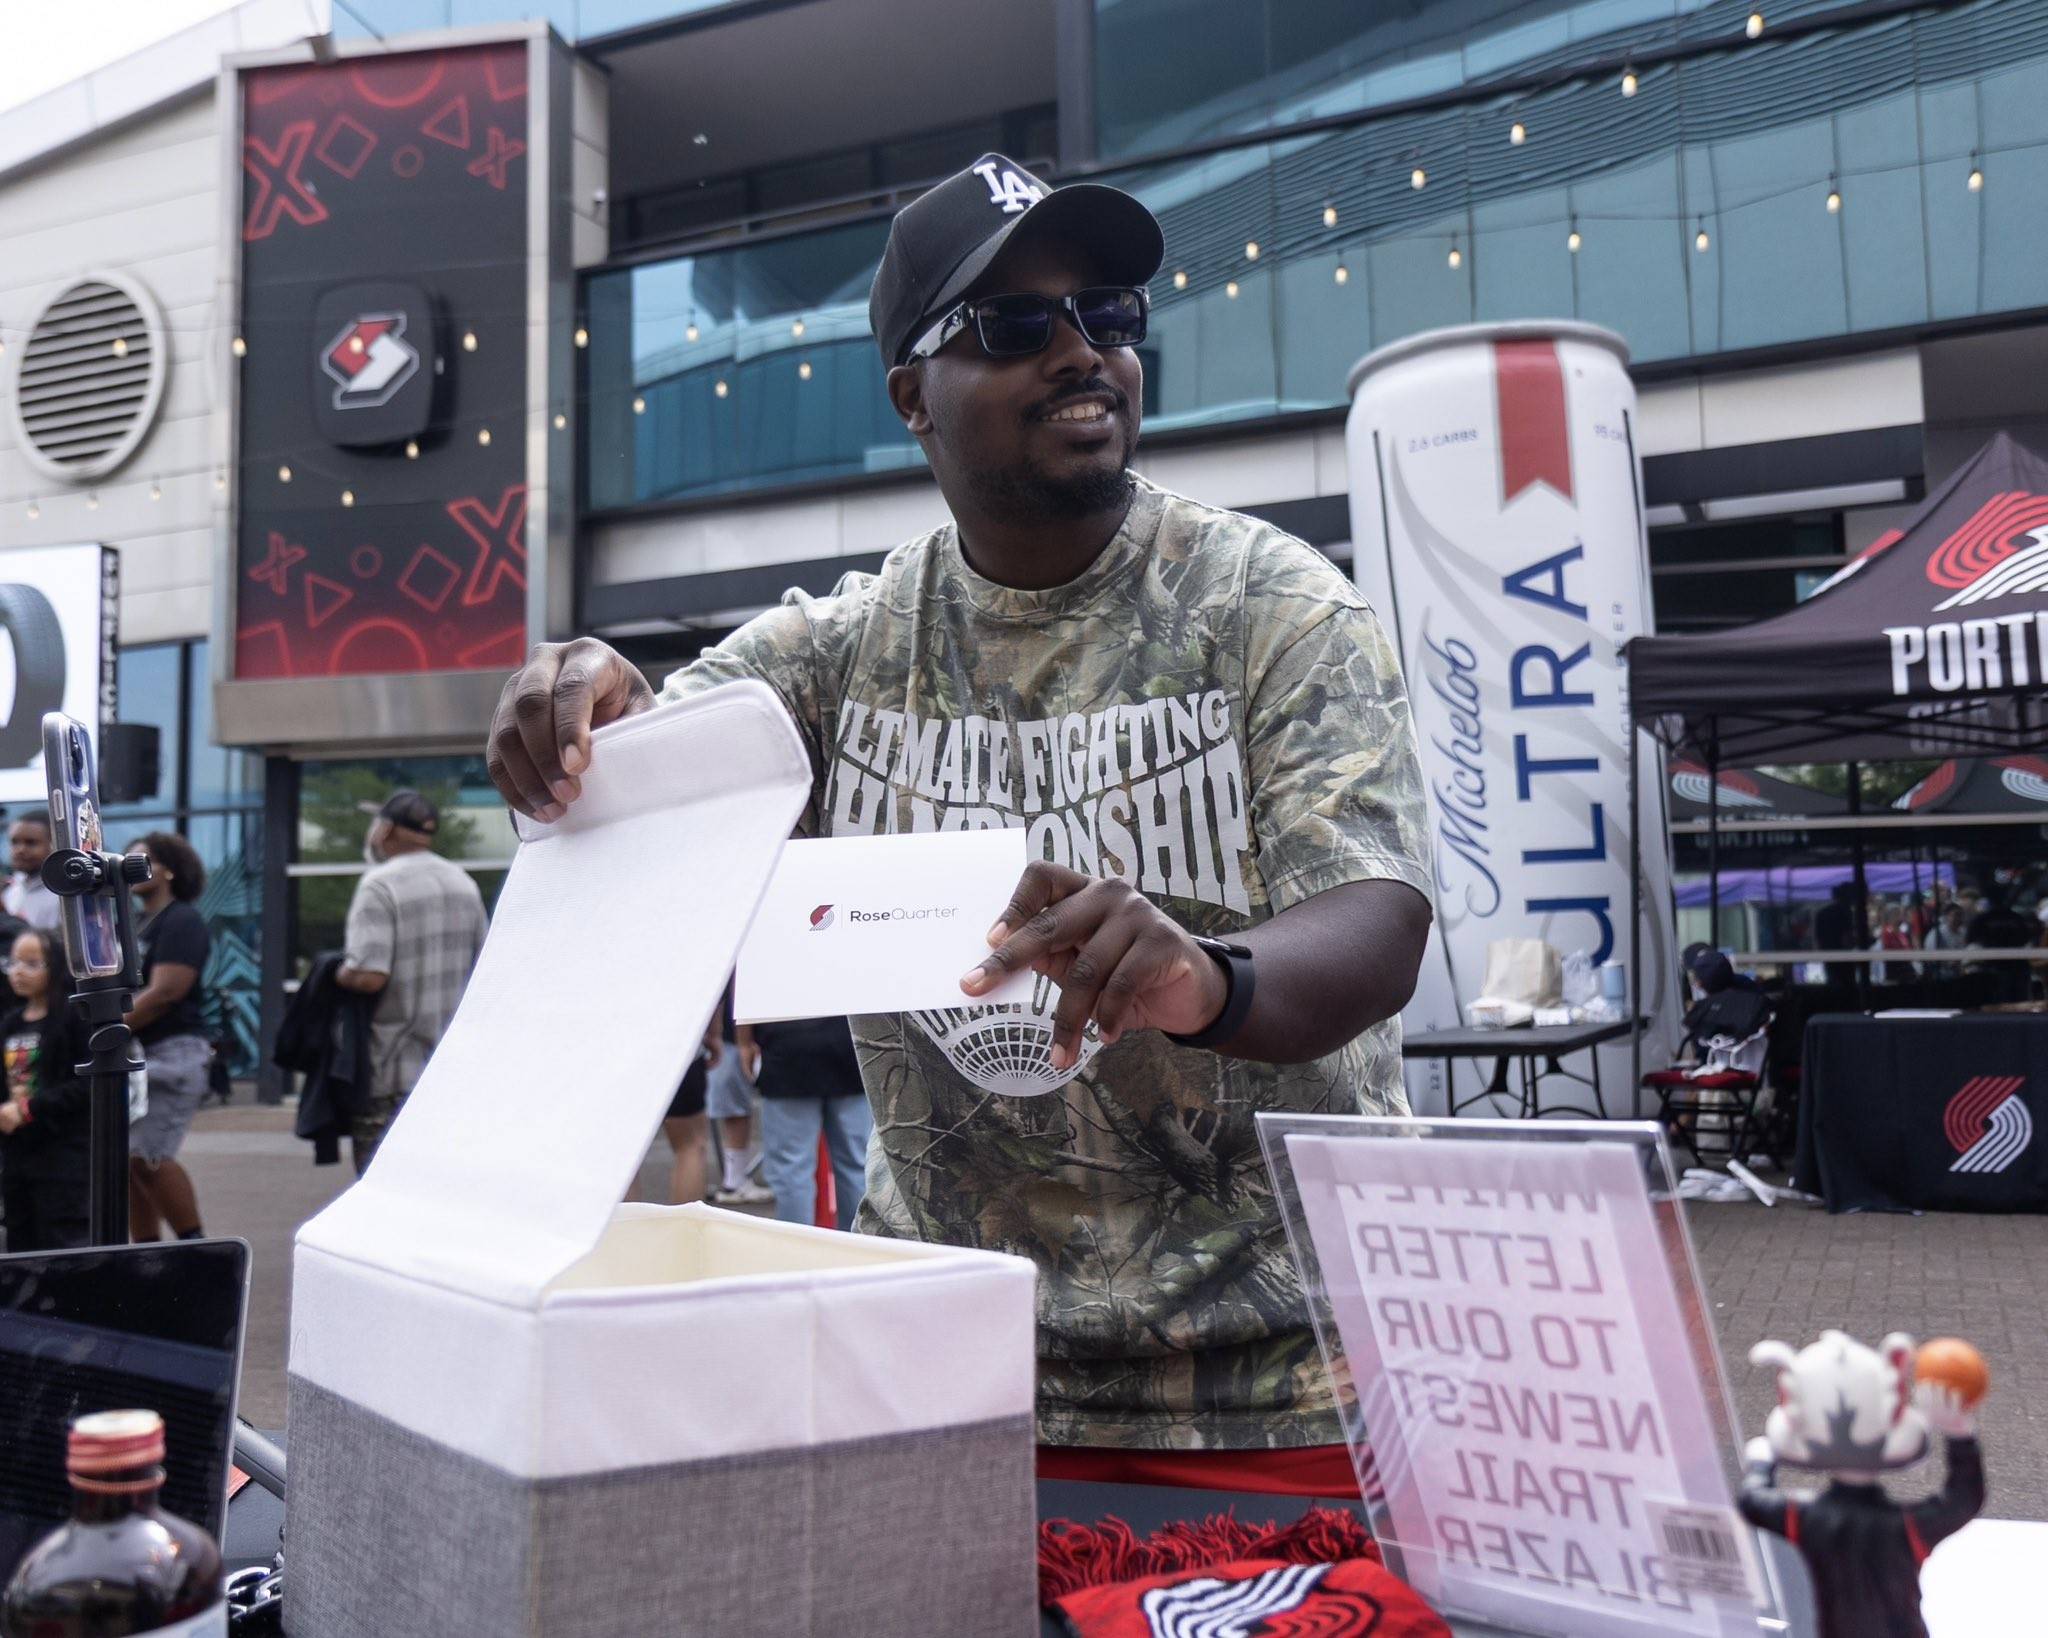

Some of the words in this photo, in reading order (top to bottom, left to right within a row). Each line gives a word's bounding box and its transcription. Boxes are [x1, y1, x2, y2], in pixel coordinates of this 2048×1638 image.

[973, 162, 1043, 213] LA
[1432, 427, 1479, 448] CARBS
[1017, 690, 1230, 812] FIGHTING
[1423, 630, 1501, 918] Michelob
[1502, 544, 1615, 971] ULTRA
[850, 905, 960, 923] RoseQuarter
